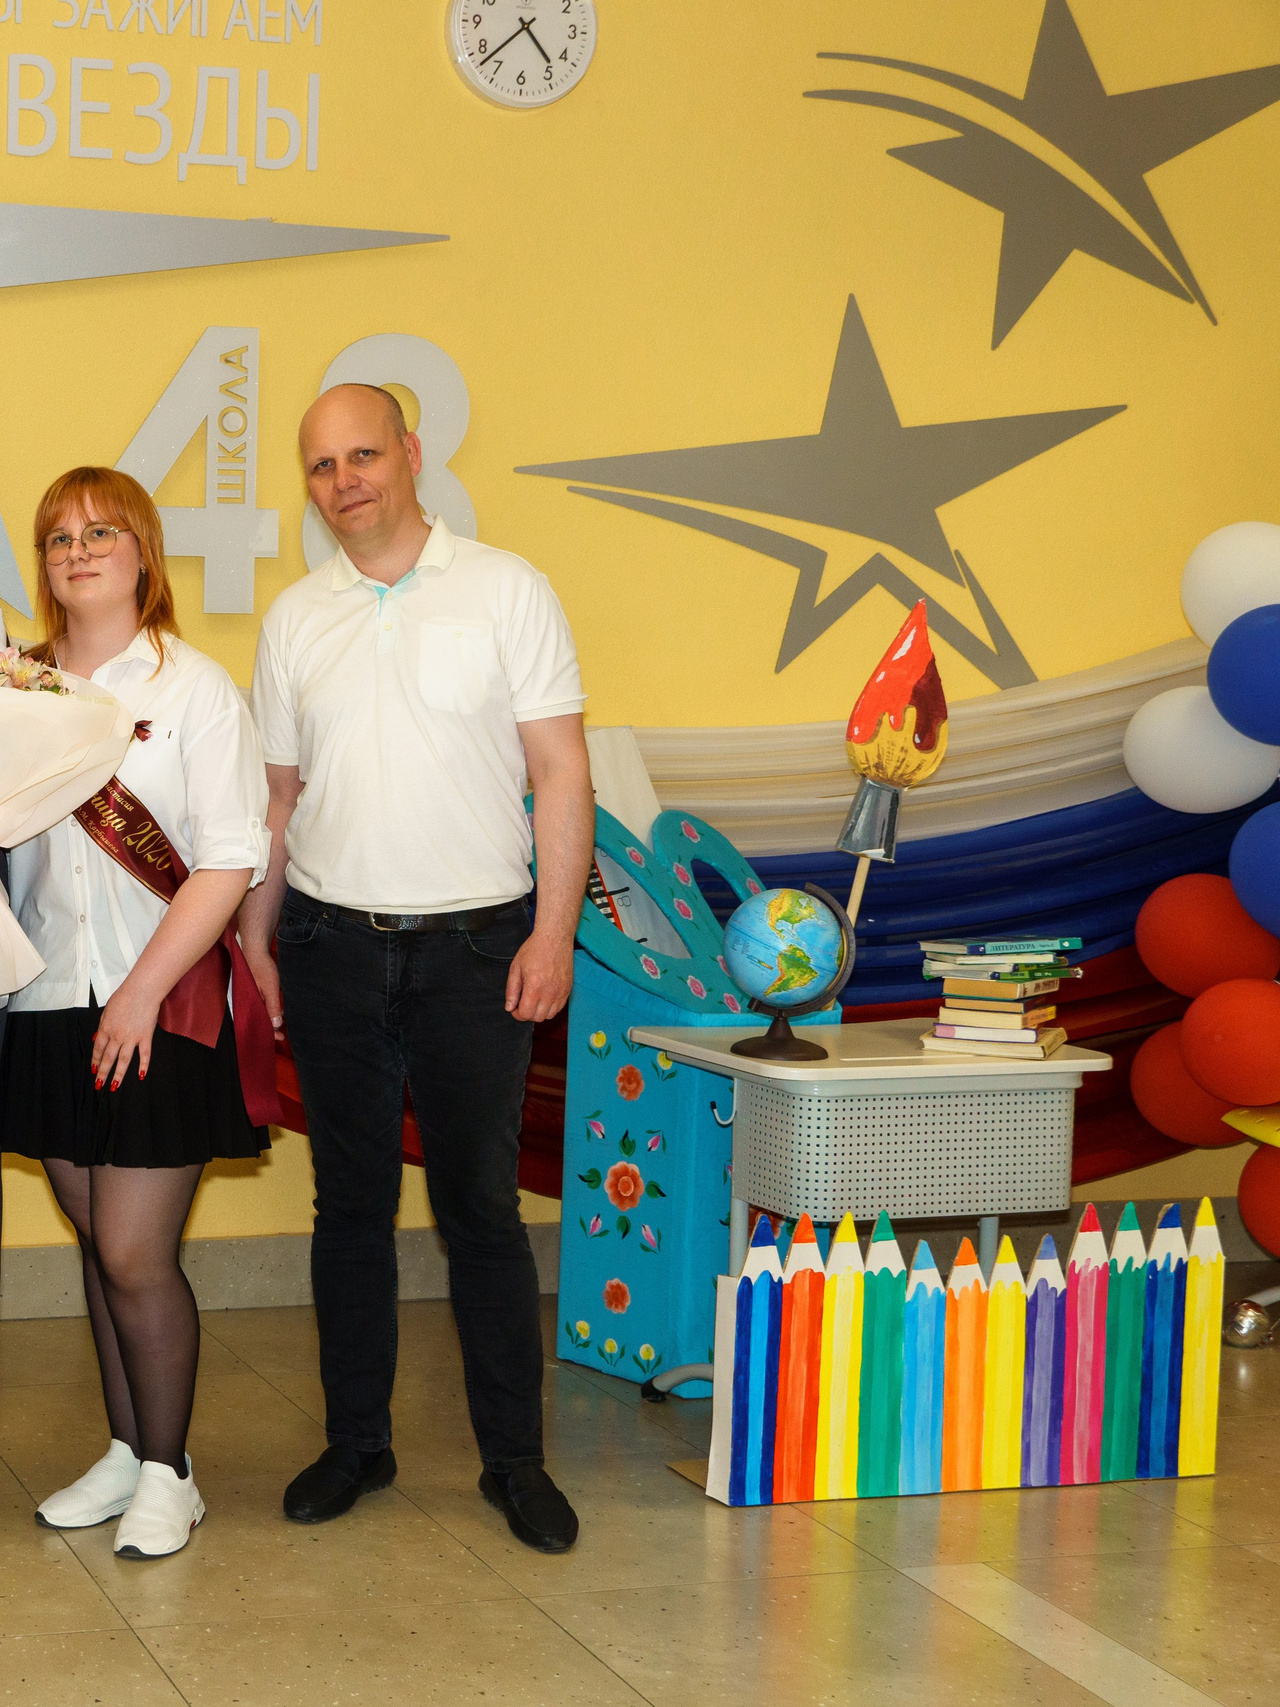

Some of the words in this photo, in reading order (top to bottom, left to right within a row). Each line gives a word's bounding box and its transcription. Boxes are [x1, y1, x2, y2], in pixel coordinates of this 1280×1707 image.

[472, 14, 482, 30] 9
[568, 24, 577, 40] 3
[478, 38, 488, 54] 8
[559, 47, 568, 63] 4
[493, 60, 503, 75] 7
[543, 65, 553, 81] 5
[516, 70, 526, 86] 6
[217, 345, 248, 504] ШКОЛА
[990, 943, 1035, 952] ЛИТЕРАТУРА
